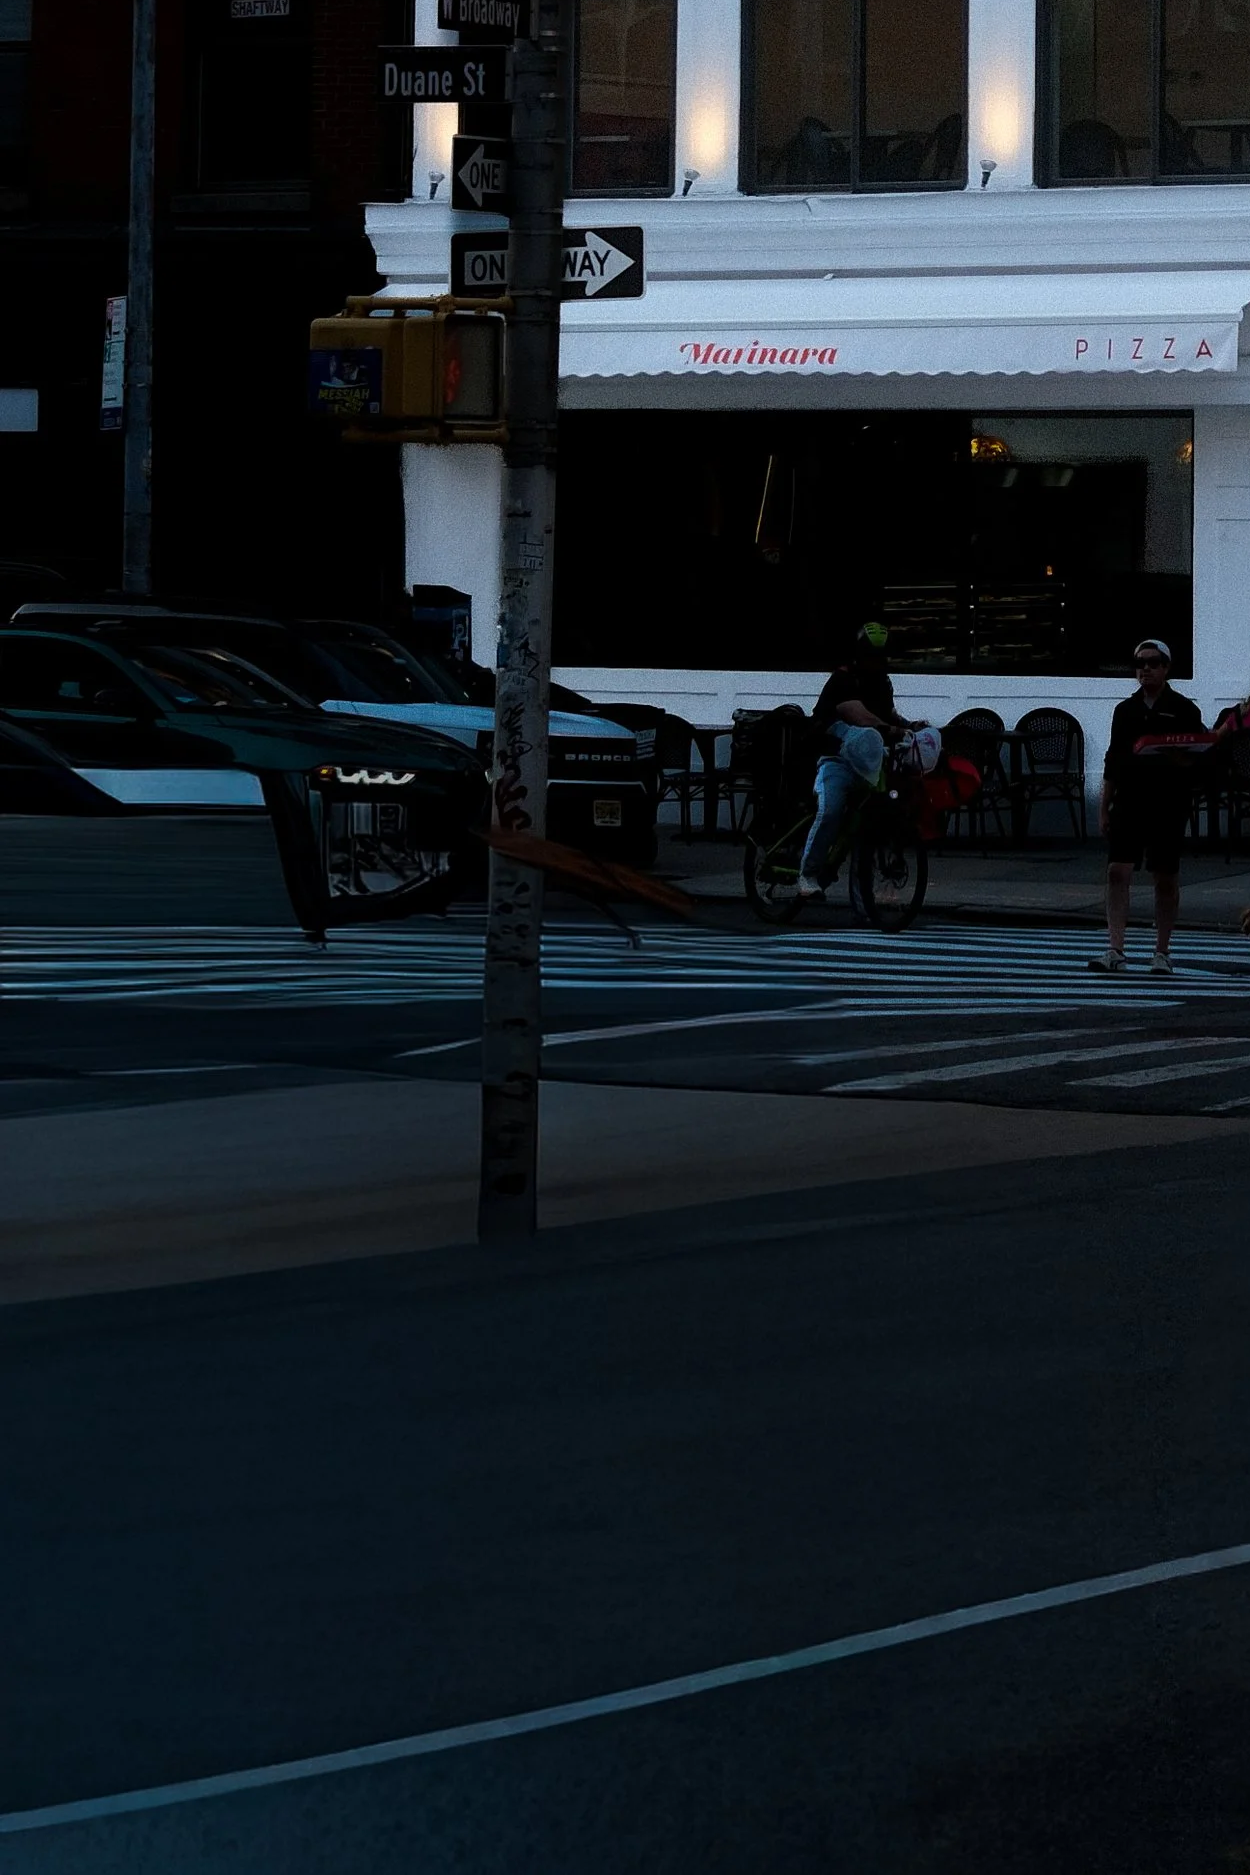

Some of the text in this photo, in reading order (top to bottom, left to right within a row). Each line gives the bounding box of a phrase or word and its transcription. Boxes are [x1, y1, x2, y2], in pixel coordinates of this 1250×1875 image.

[384, 61, 486, 97] Duane St
[470, 162, 501, 190] ONE
[471, 254, 505, 281] ON
[679, 337, 1213, 365] Marinara PIZZA
